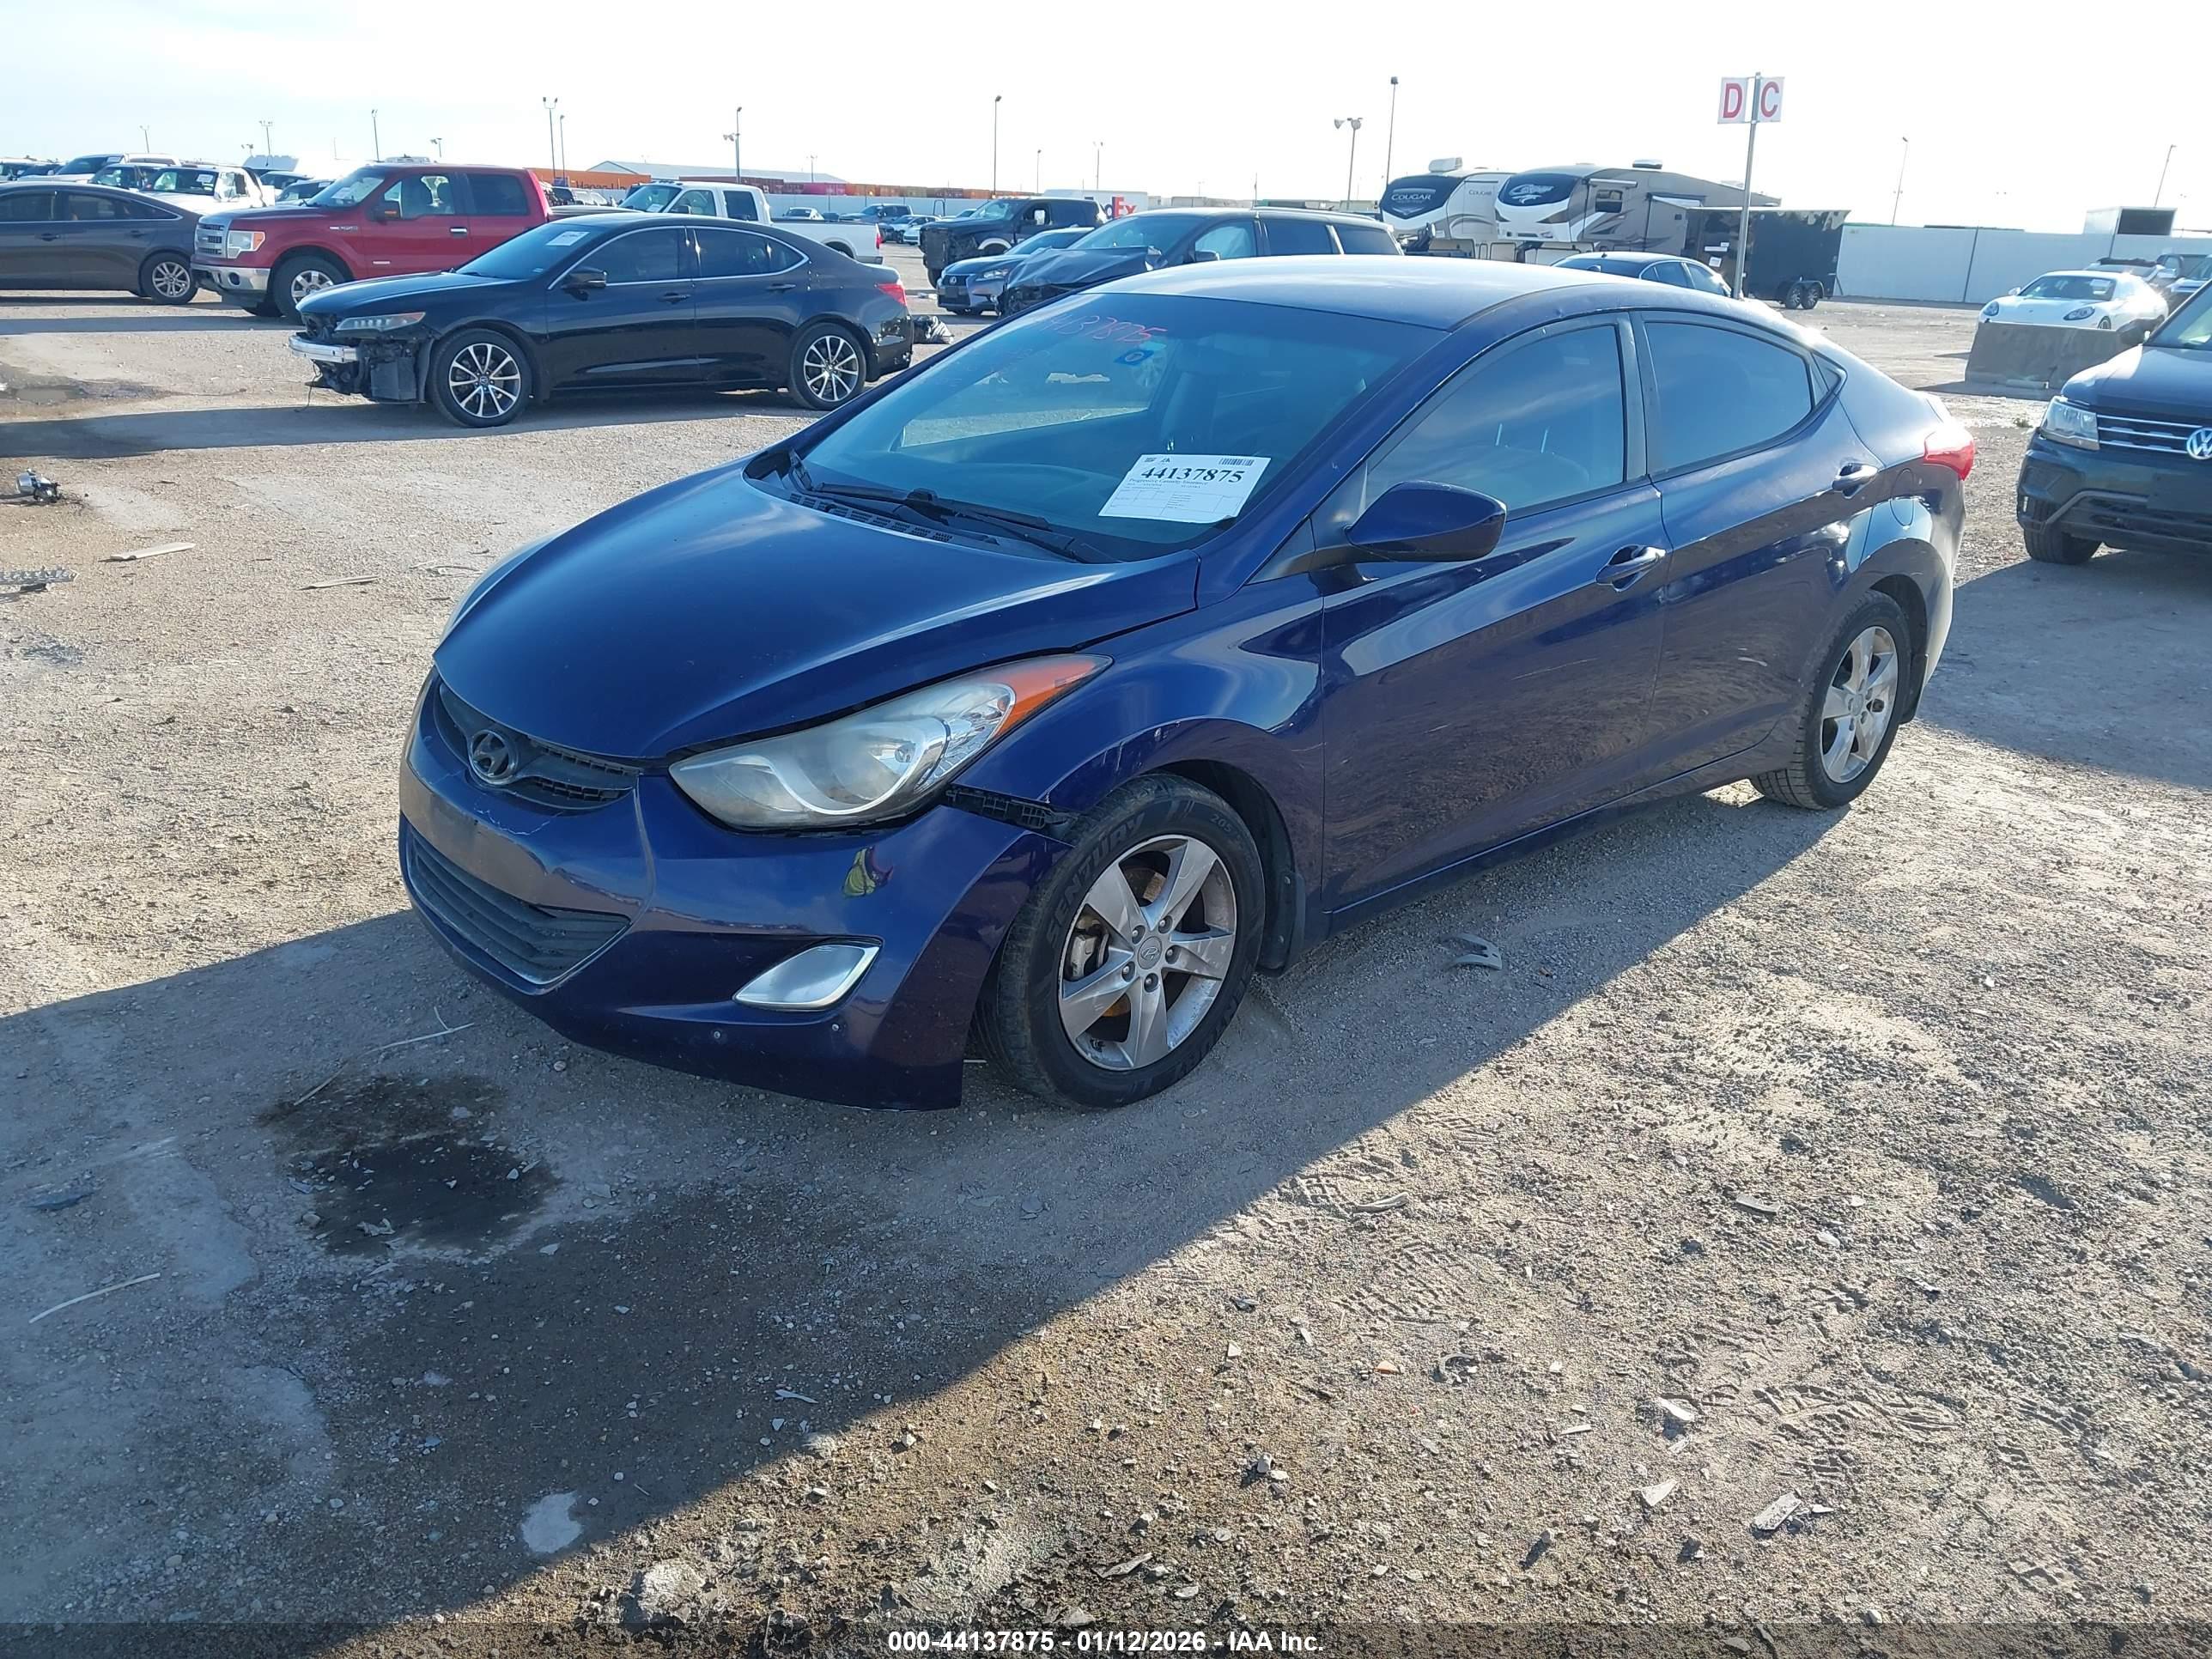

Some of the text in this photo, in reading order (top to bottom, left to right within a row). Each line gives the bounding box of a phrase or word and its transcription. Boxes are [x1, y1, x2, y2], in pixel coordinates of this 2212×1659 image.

[1723, 82, 1743, 118] D
[1760, 82, 1780, 118] C
[1140, 467, 1246, 483] 44137875
